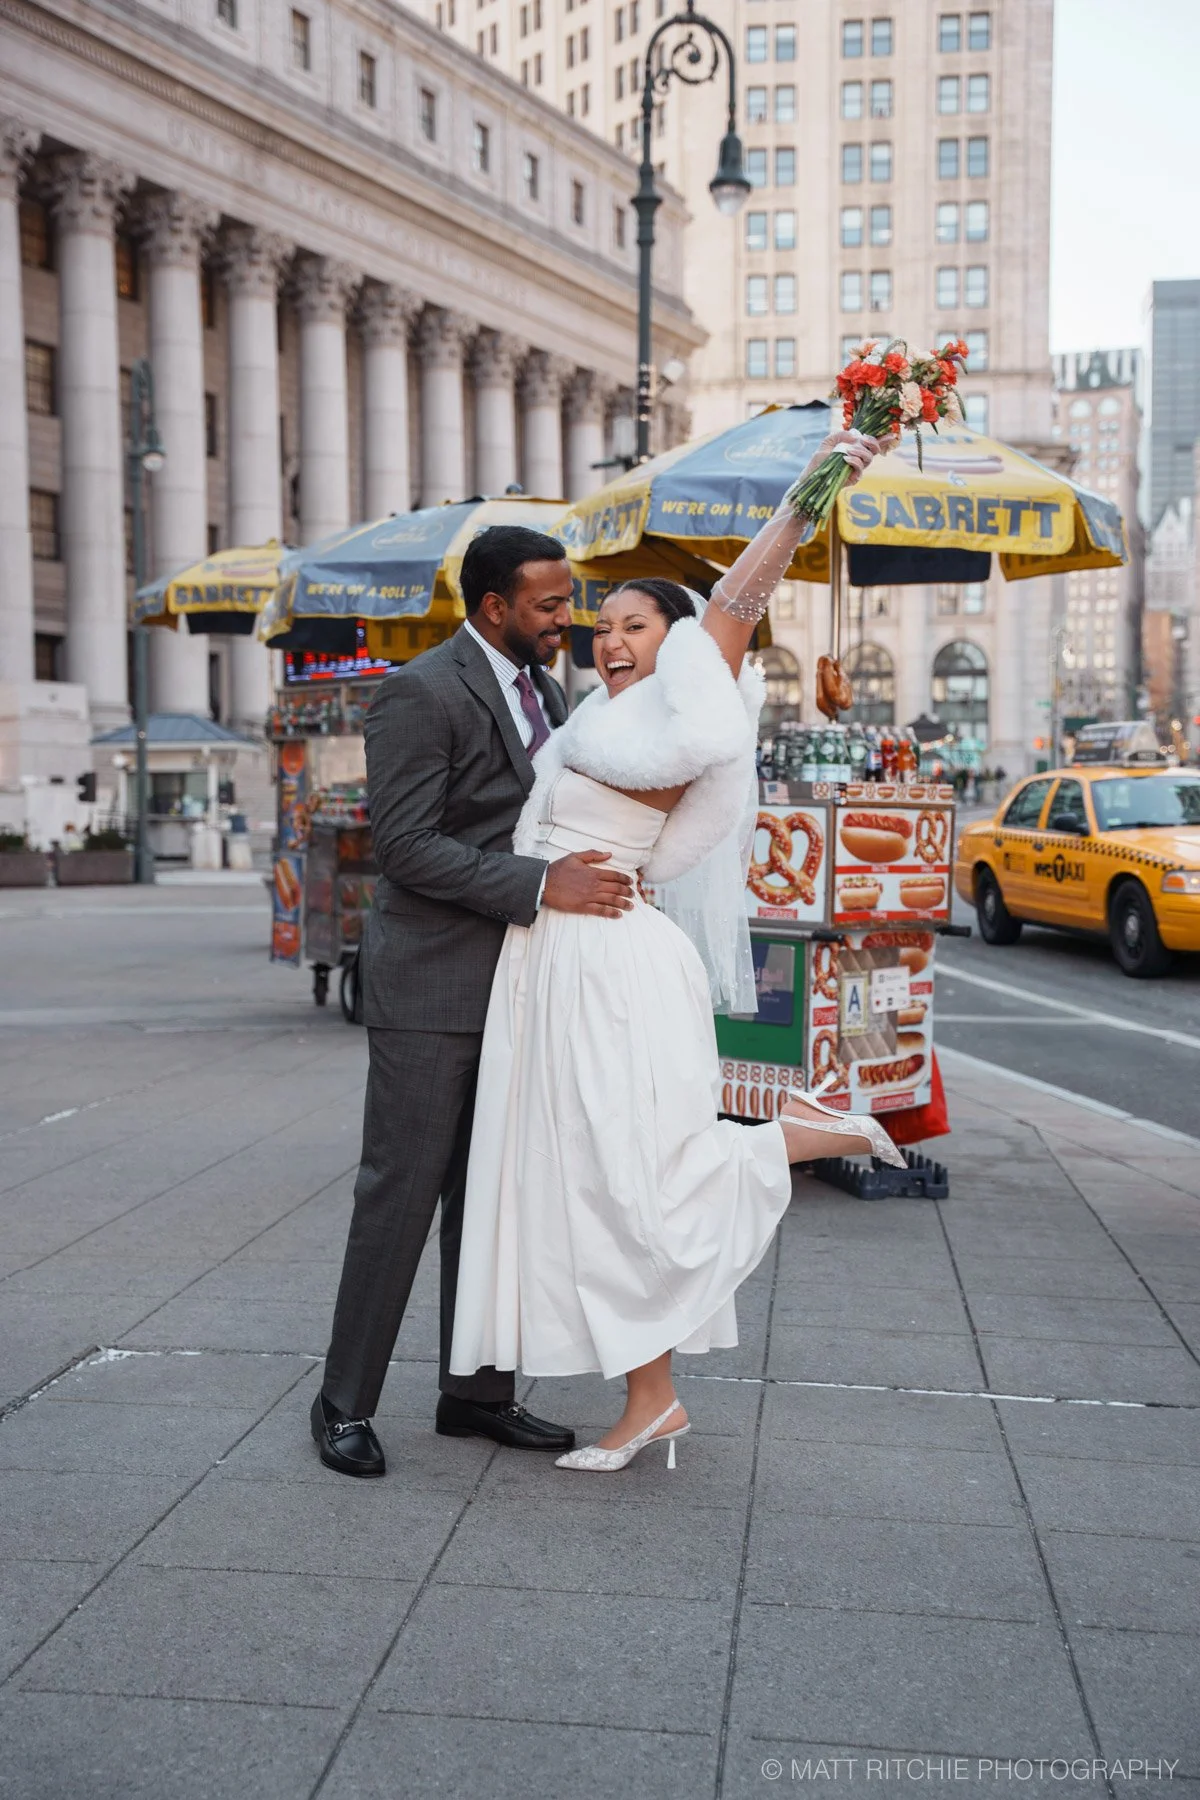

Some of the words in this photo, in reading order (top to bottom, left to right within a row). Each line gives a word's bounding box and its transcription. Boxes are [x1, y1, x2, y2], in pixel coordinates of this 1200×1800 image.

[661, 501, 706, 515] WE'RE
[710, 502, 730, 516] ON
[849, 492, 1061, 538] SABRETT
[307, 583, 343, 595] WE'RE
[367, 586, 377, 598] A
[380, 586, 406, 599] ROLL
[848, 984, 861, 1013] A
